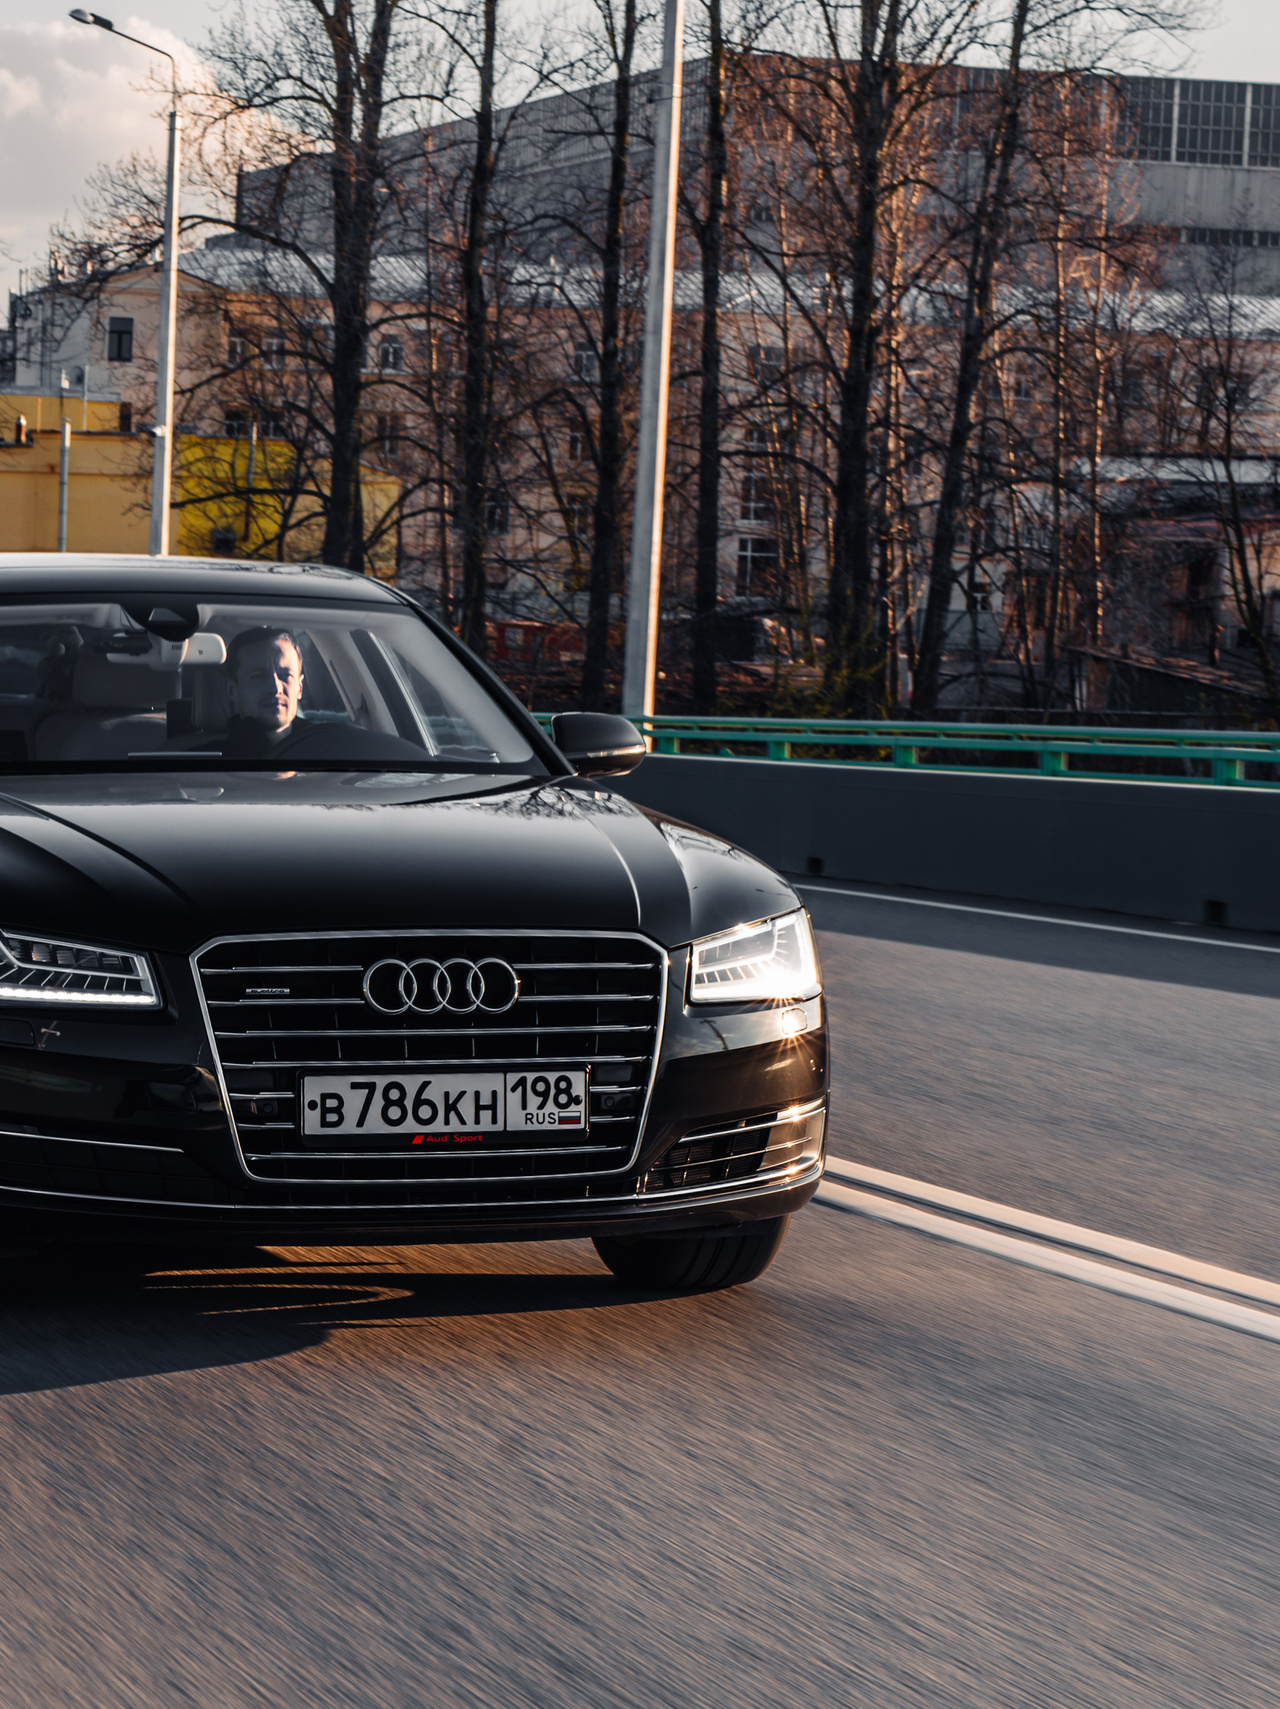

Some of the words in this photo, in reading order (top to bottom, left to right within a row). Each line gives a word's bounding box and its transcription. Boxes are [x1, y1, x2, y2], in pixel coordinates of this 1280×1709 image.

[510, 1075, 573, 1111] 198
[524, 1112, 557, 1125] RUS
[453, 1134, 483, 1144] Sport
